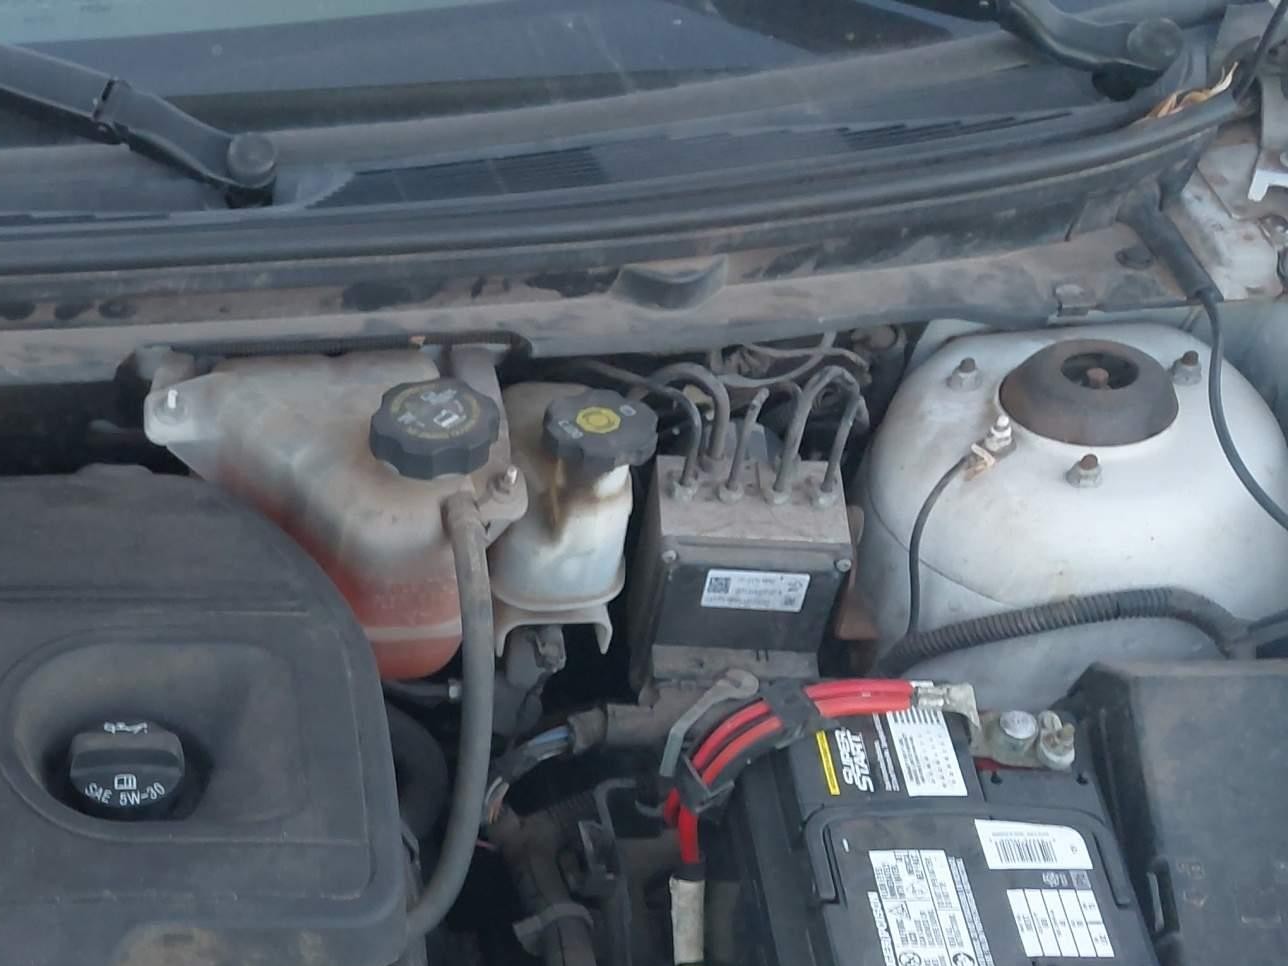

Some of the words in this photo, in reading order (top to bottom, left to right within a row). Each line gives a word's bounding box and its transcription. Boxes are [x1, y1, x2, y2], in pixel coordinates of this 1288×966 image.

[834, 729, 854, 785] SUPER
[846, 729, 875, 793] START
[84, 782, 112, 804] SAE
[119, 782, 166, 806] 5W-30
